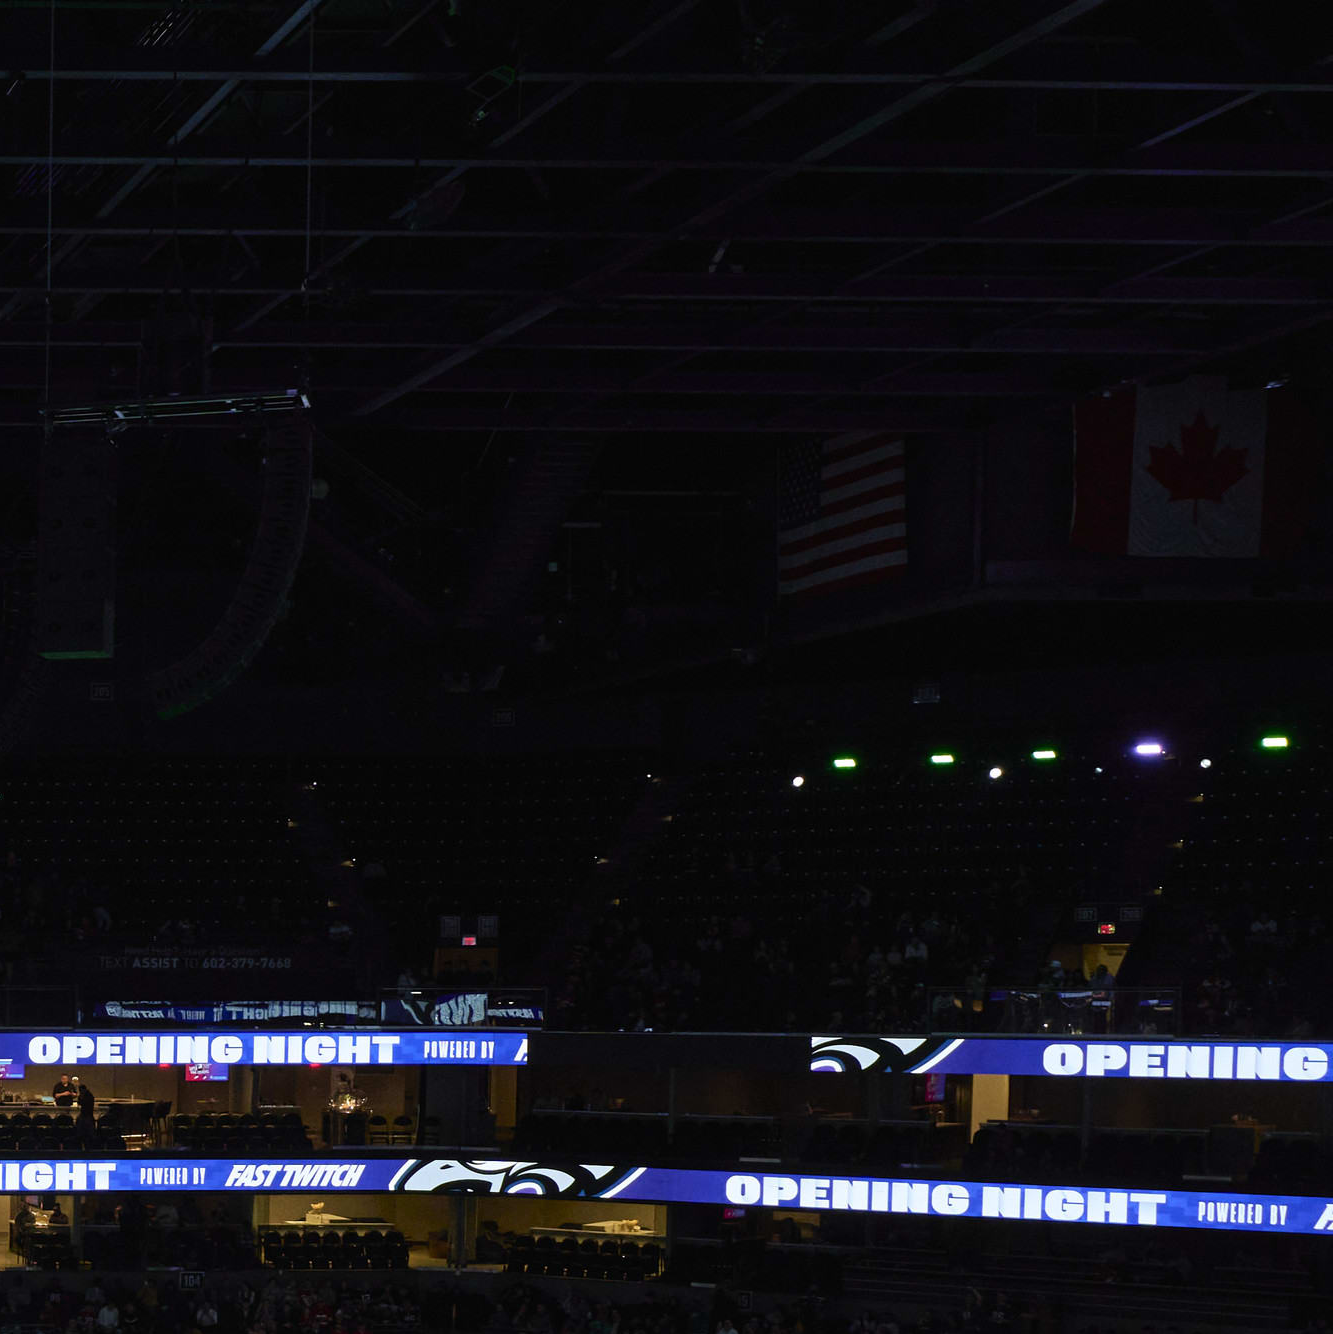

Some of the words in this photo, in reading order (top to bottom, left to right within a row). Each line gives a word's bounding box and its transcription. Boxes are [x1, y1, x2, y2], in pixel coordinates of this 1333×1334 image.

[133, 956, 180, 969] ASSIST
[28, 1035, 243, 1065] OPENING
[253, 1035, 401, 1064] NIGHT
[423, 1040, 476, 1060] POWERED
[480, 1040, 496, 1059] BY
[1043, 1043, 1329, 1081] OPENING
[139, 1167, 188, 1186] POWERED
[190, 1167, 206, 1185] BY
[224, 1165, 285, 1187] FAST
[279, 1165, 367, 1187] TWITCH
[725, 1174, 970, 1216] OPENING
[982, 1185, 1166, 1226] NIGHT
[1197, 1201, 1263, 1225] POWERED
[1269, 1204, 1288, 1226] BY
